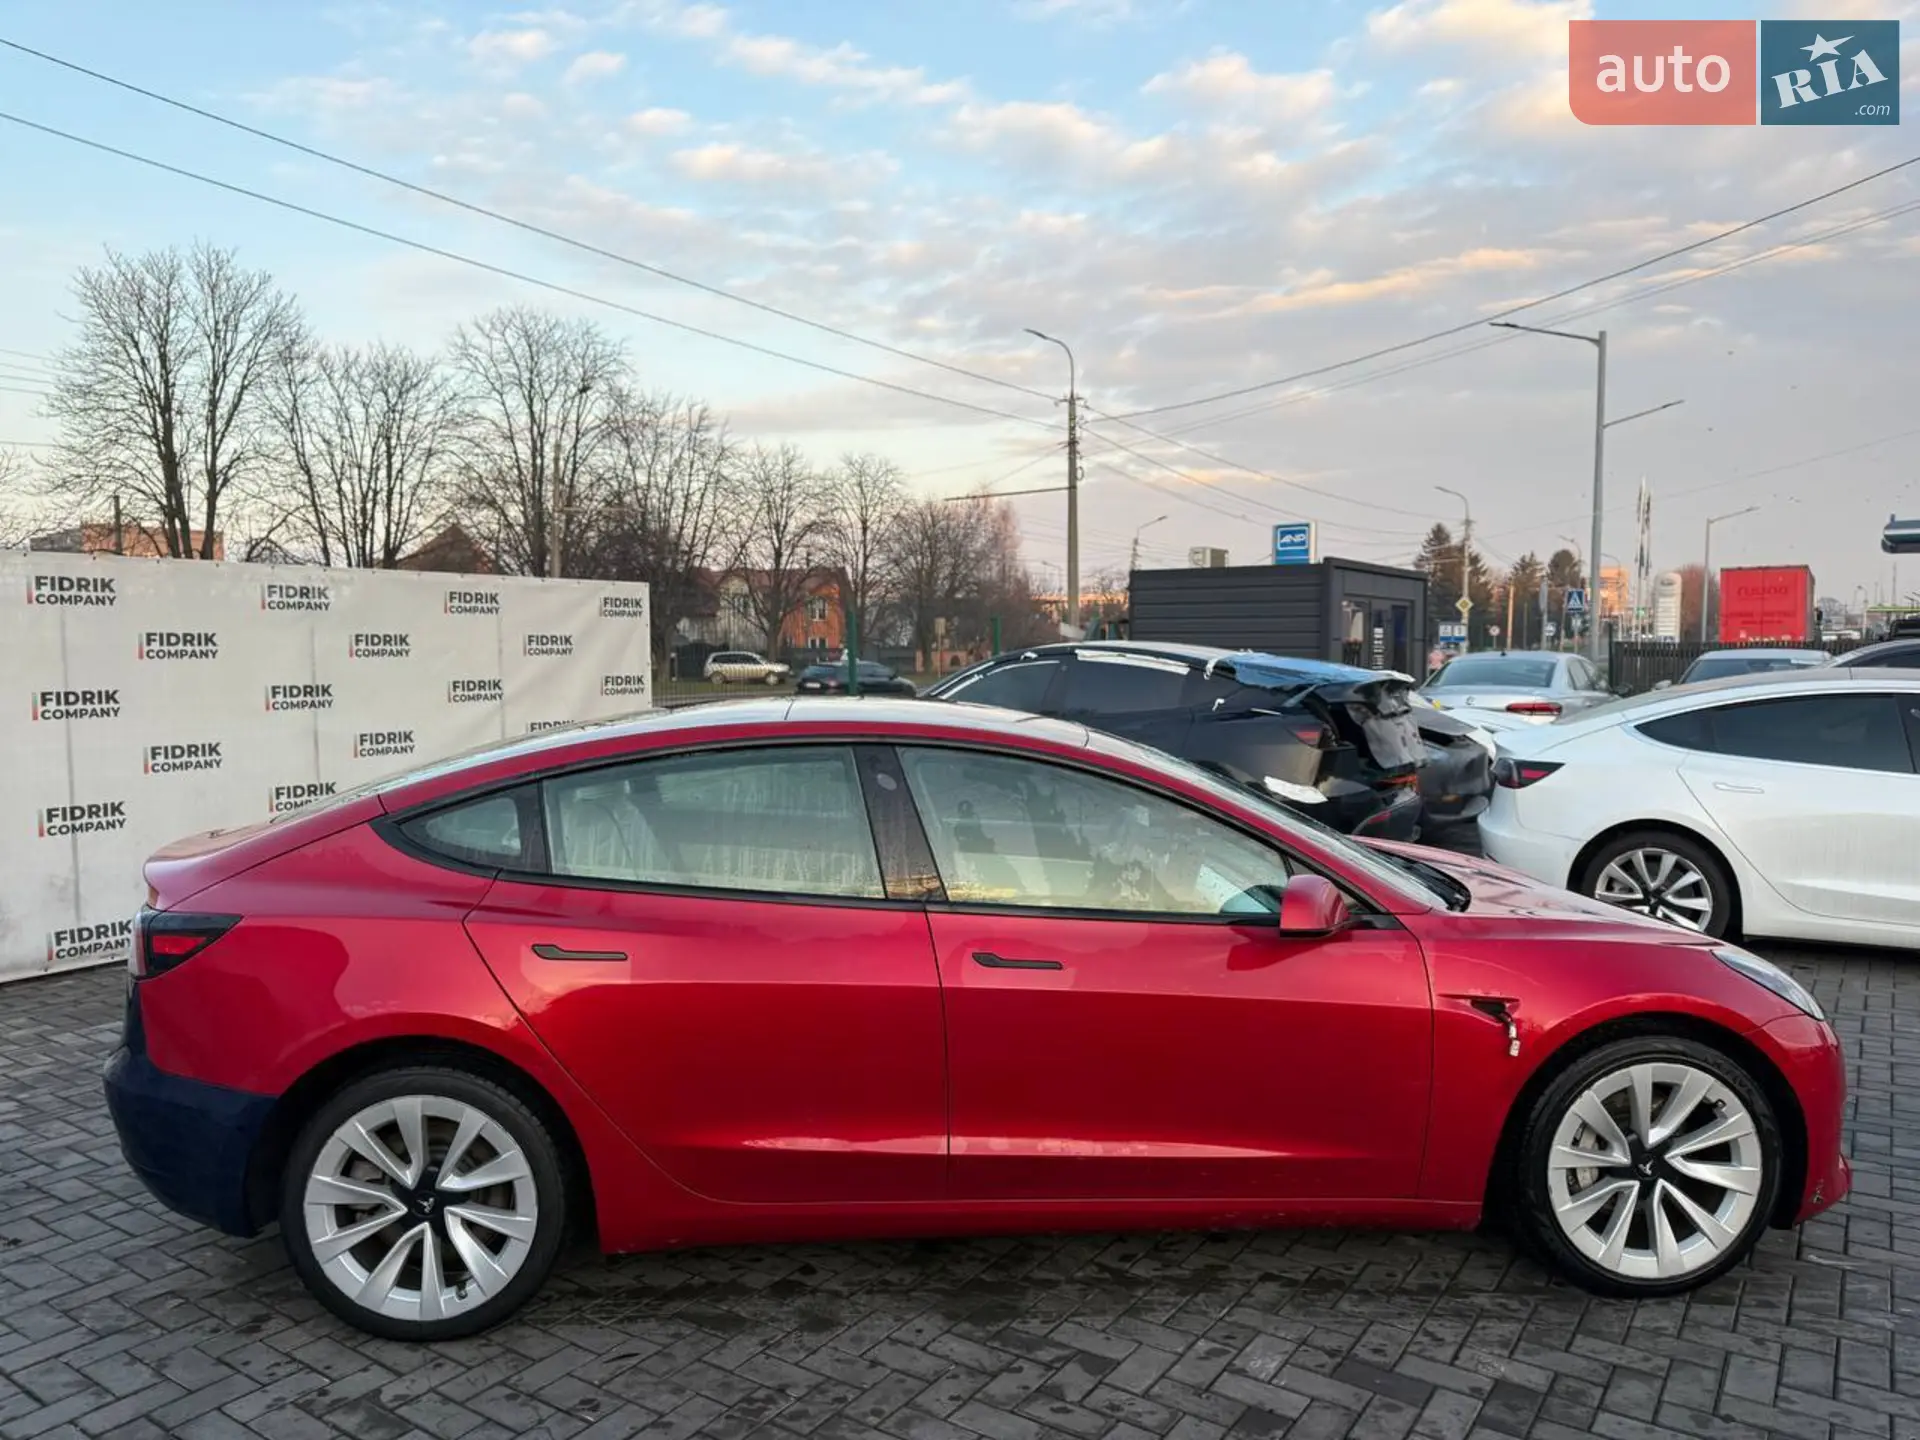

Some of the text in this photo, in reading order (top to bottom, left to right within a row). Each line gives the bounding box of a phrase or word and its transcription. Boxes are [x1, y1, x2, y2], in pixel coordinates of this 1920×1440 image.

[34, 575, 117, 593] FIDRIK
[267, 584, 330, 600] FIDRIK
[449, 591, 500, 605] FIDRIK
[35, 593, 117, 606] COMPANY
[267, 600, 331, 611] COMPANY
[603, 597, 643, 609] FIDRIK
[449, 605, 500, 615] COMPANY
[603, 609, 643, 618] COMPANY
[145, 632, 217, 647] FIDRIK
[354, 633, 410, 647] FIDRIK
[527, 634, 573, 646] FIDRIK
[146, 649, 219, 660] COMPANY
[355, 648, 411, 658] COMPANY
[527, 647, 574, 656] COMPANY
[452, 679, 503, 693] FIDRIK
[604, 675, 645, 687] FIDRIK
[39, 689, 120, 707] FIDRIK
[271, 684, 334, 699] FIDRIK
[452, 693, 504, 703] COMPANY
[604, 687, 645, 697] COMPANY
[271, 699, 334, 711] COMPANY
[40, 706, 120, 721] COMPANY
[359, 730, 414, 746] FIDRIK
[150, 742, 221, 761] FIDRIK
[359, 745, 415, 758] COMPANY
[151, 758, 222, 773] COMPANY
[275, 781, 337, 800] FIDRIK
[46, 801, 125, 824] FIDRIK
[46, 818, 127, 837] COMPANY
[54, 919, 132, 947] FIDRIK
